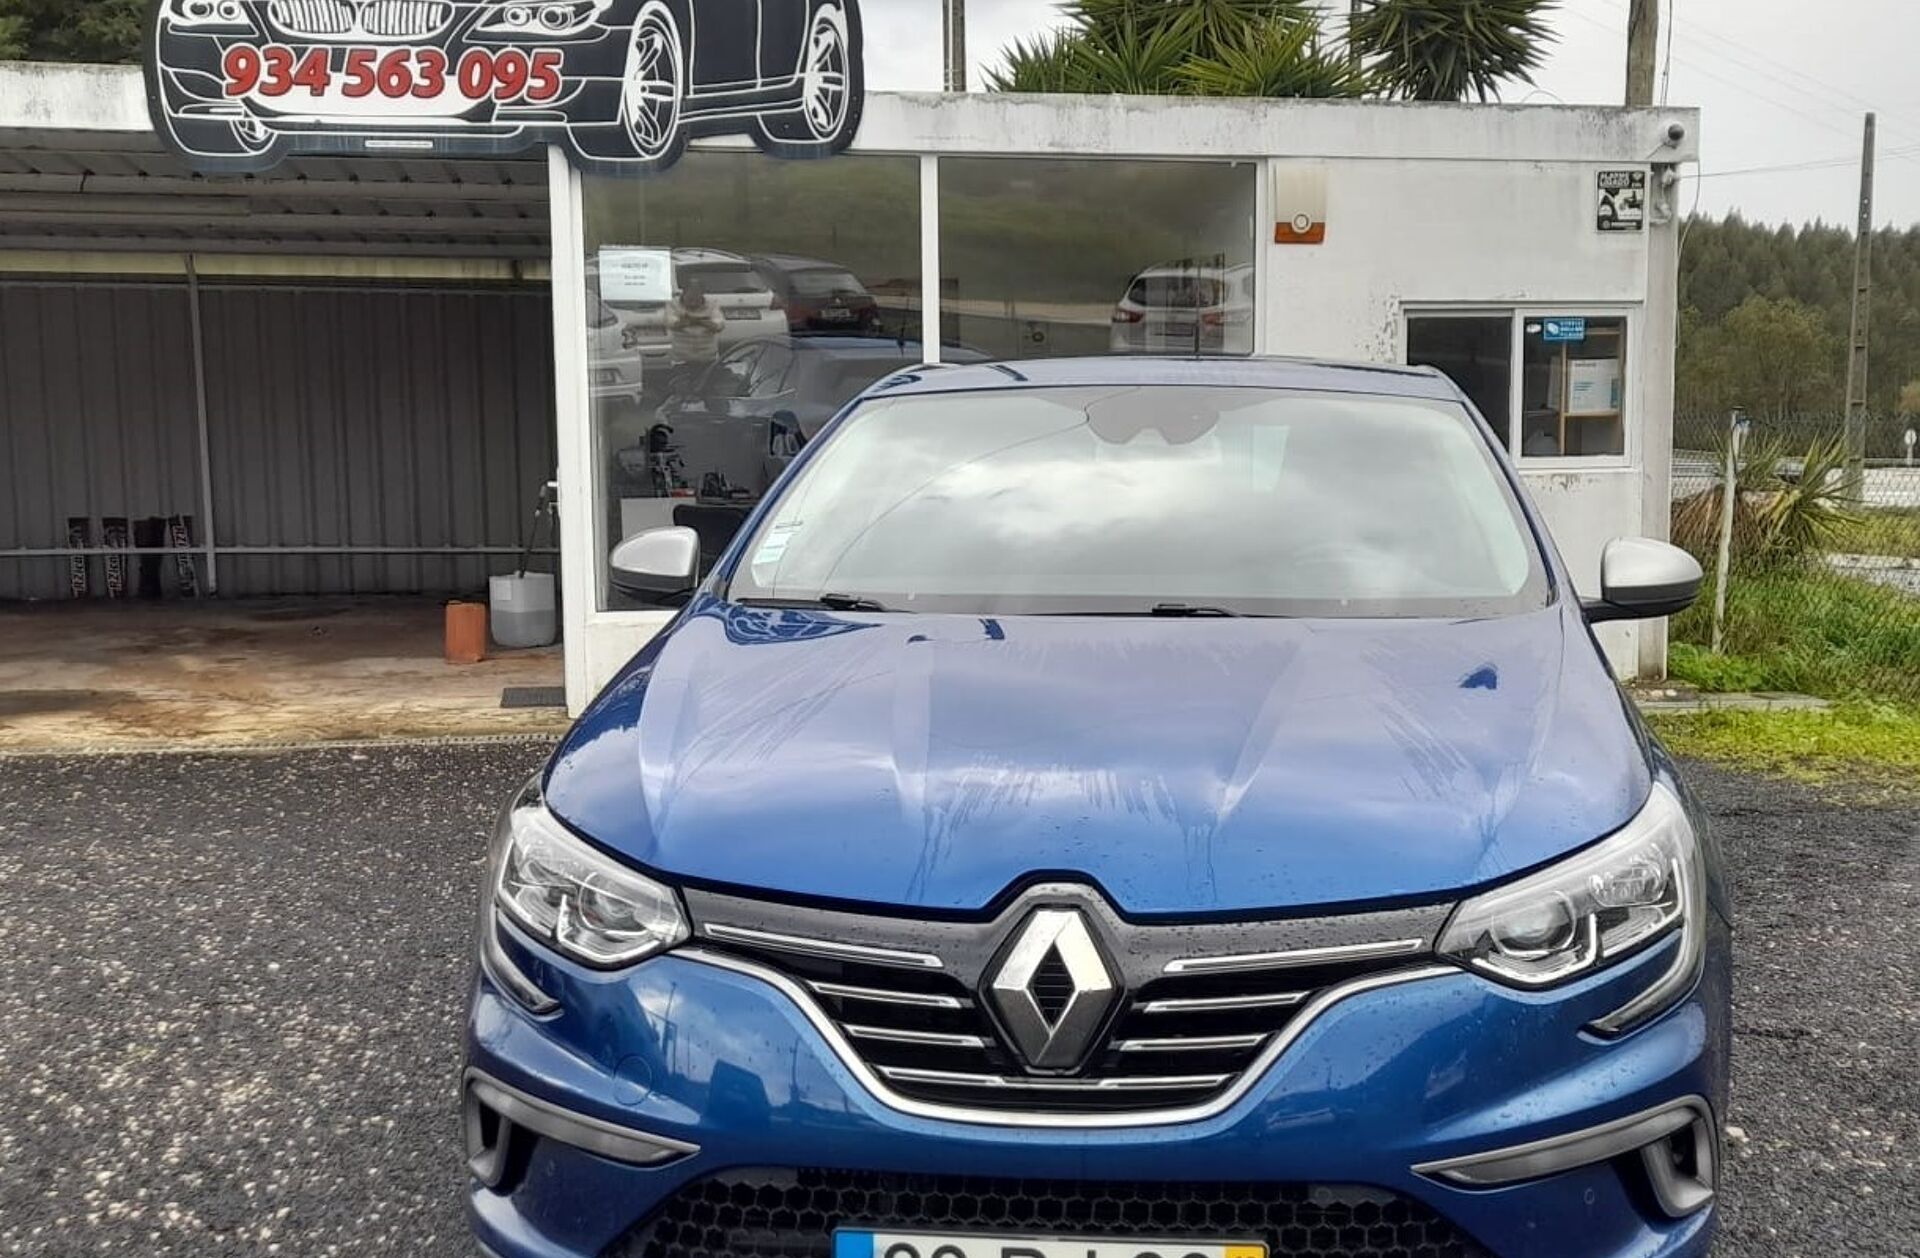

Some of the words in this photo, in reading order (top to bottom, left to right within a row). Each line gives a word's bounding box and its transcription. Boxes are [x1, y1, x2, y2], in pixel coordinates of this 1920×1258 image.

[223, 44, 331, 97] 934
[341, 46, 446, 99] 563
[457, 49, 562, 101] 095
